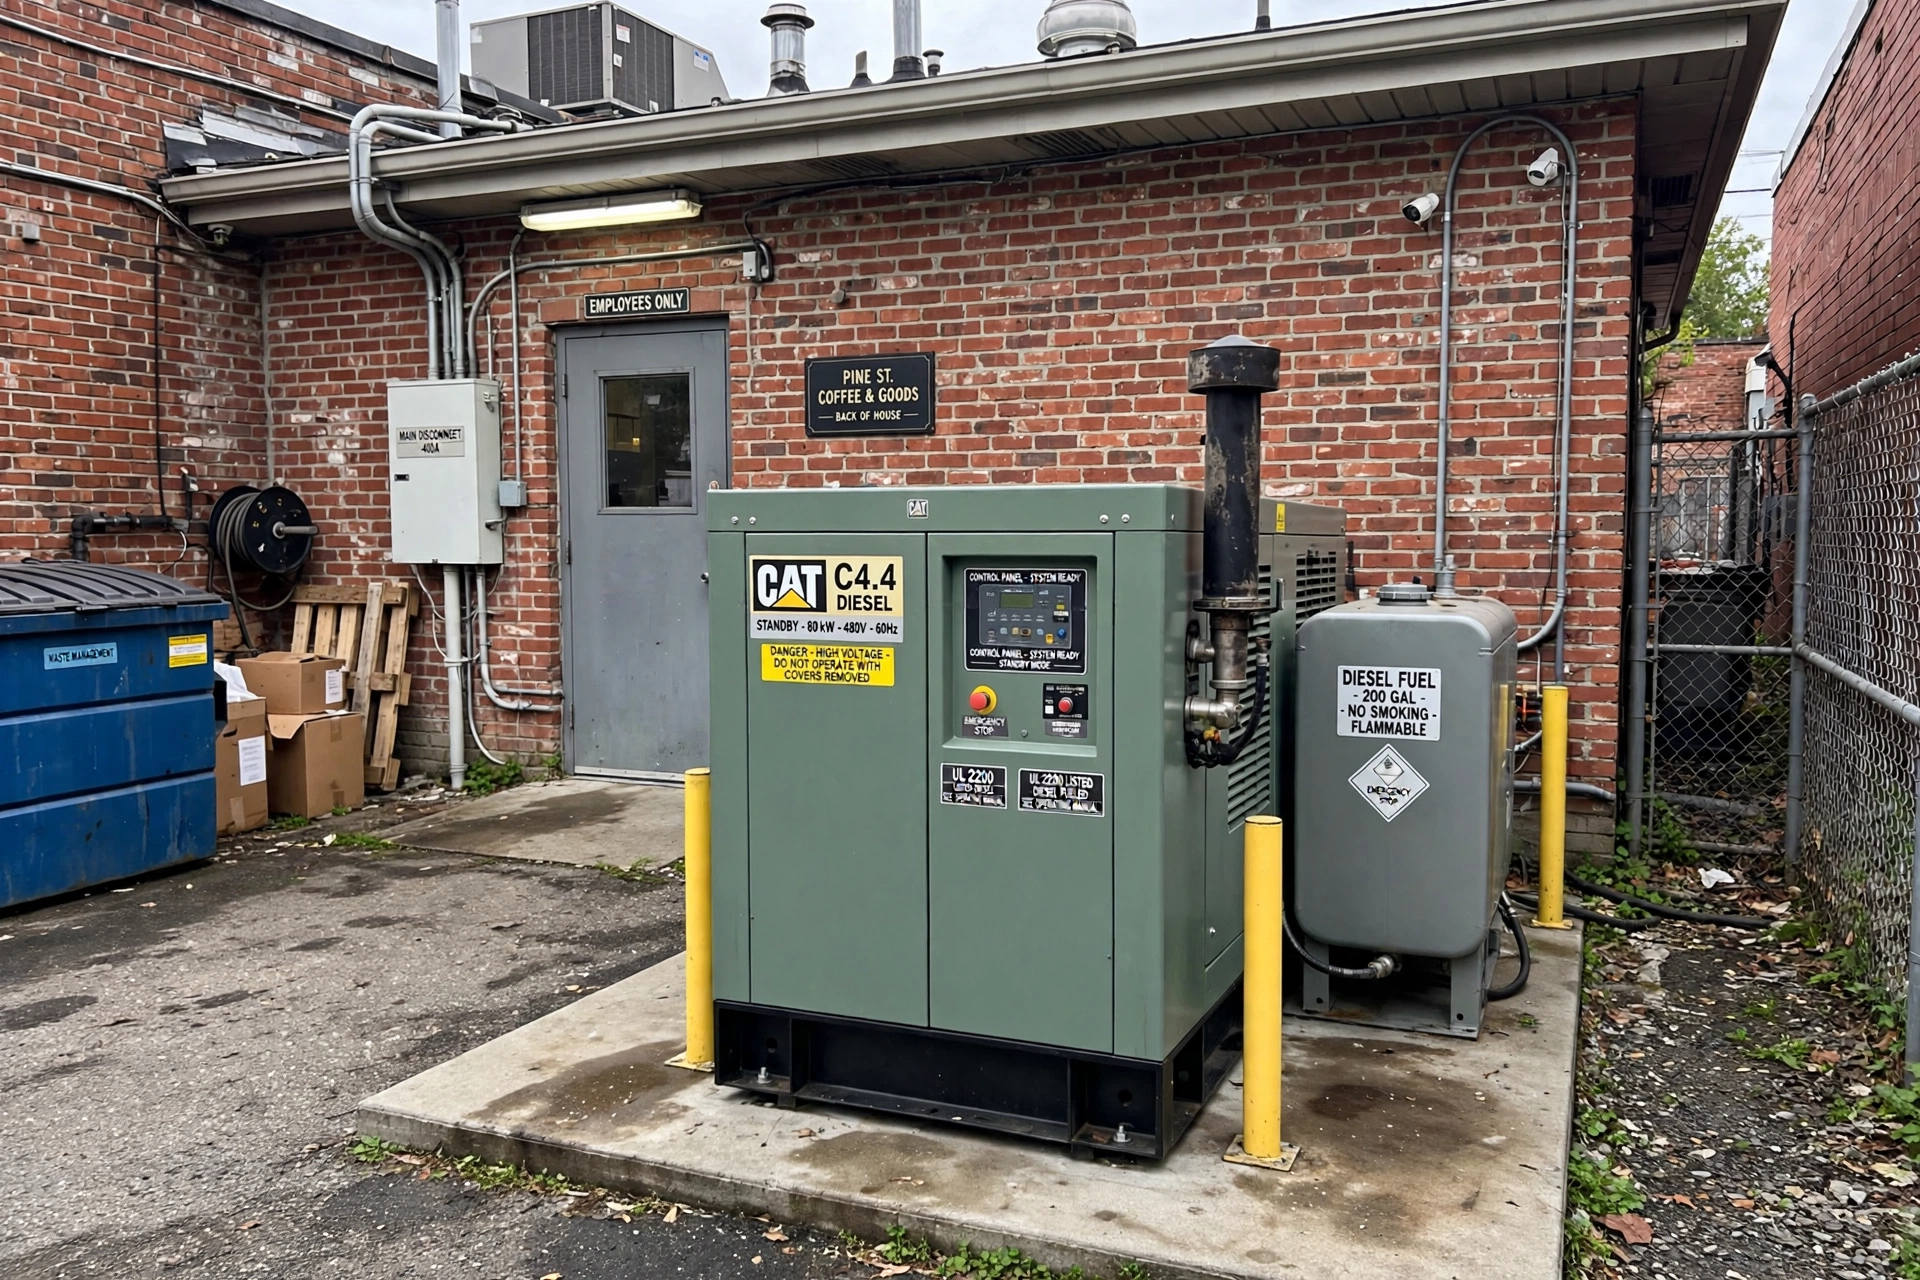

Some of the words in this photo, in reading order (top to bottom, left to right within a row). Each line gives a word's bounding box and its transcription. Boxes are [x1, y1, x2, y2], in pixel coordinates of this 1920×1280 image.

[590, 295, 651, 313] EMPLOYEES
[655, 293, 683, 309] ONLY
[843, 369, 871, 385] PINE
[877, 368, 893, 383] ST.
[818, 389, 861, 405] COFFEE
[865, 388, 874, 403] &
[878, 387, 919, 402] GOODS
[836, 411, 857, 422] BACK
[860, 411, 870, 420] OF
[873, 410, 901, 420] HOUSE
[834, 563, 896, 590] C4.4
[969, 573, 999, 582] CONTROL
[757, 564, 822, 608] CAT
[837, 595, 892, 611] DIESEL
[757, 619, 799, 632] STANDBY
[807, 621, 818, 632] 80
[820, 621, 835, 633] kW
[843, 622, 867, 634] 480V
[875, 623, 898, 634] 60Hz
[770, 646, 808, 657] DANGER
[816, 647, 839, 658] HIGH
[841, 648, 883, 659] VOLTAGE
[774, 658, 787, 668] DO
[790, 658, 809, 669] NOT
[812, 660, 854, 671] OPERATE
[857, 661, 881, 671] WITH
[784, 670, 821, 681] COVERS
[824, 671, 870, 683] REMOVED
[1343, 670, 1393, 687] DIESEL
[1399, 672, 1436, 688] FUEL
[1363, 689, 1386, 703] 200
[1390, 691, 1416, 704] GAL
[1348, 704, 1366, 717] NO
[1371, 706, 1429, 720] SMOKING
[1351, 720, 1426, 736] FLAMMABLE
[952, 768, 965, 782] UL
[968, 769, 994, 784] 2200
[1029, 773, 1039, 784] UL
